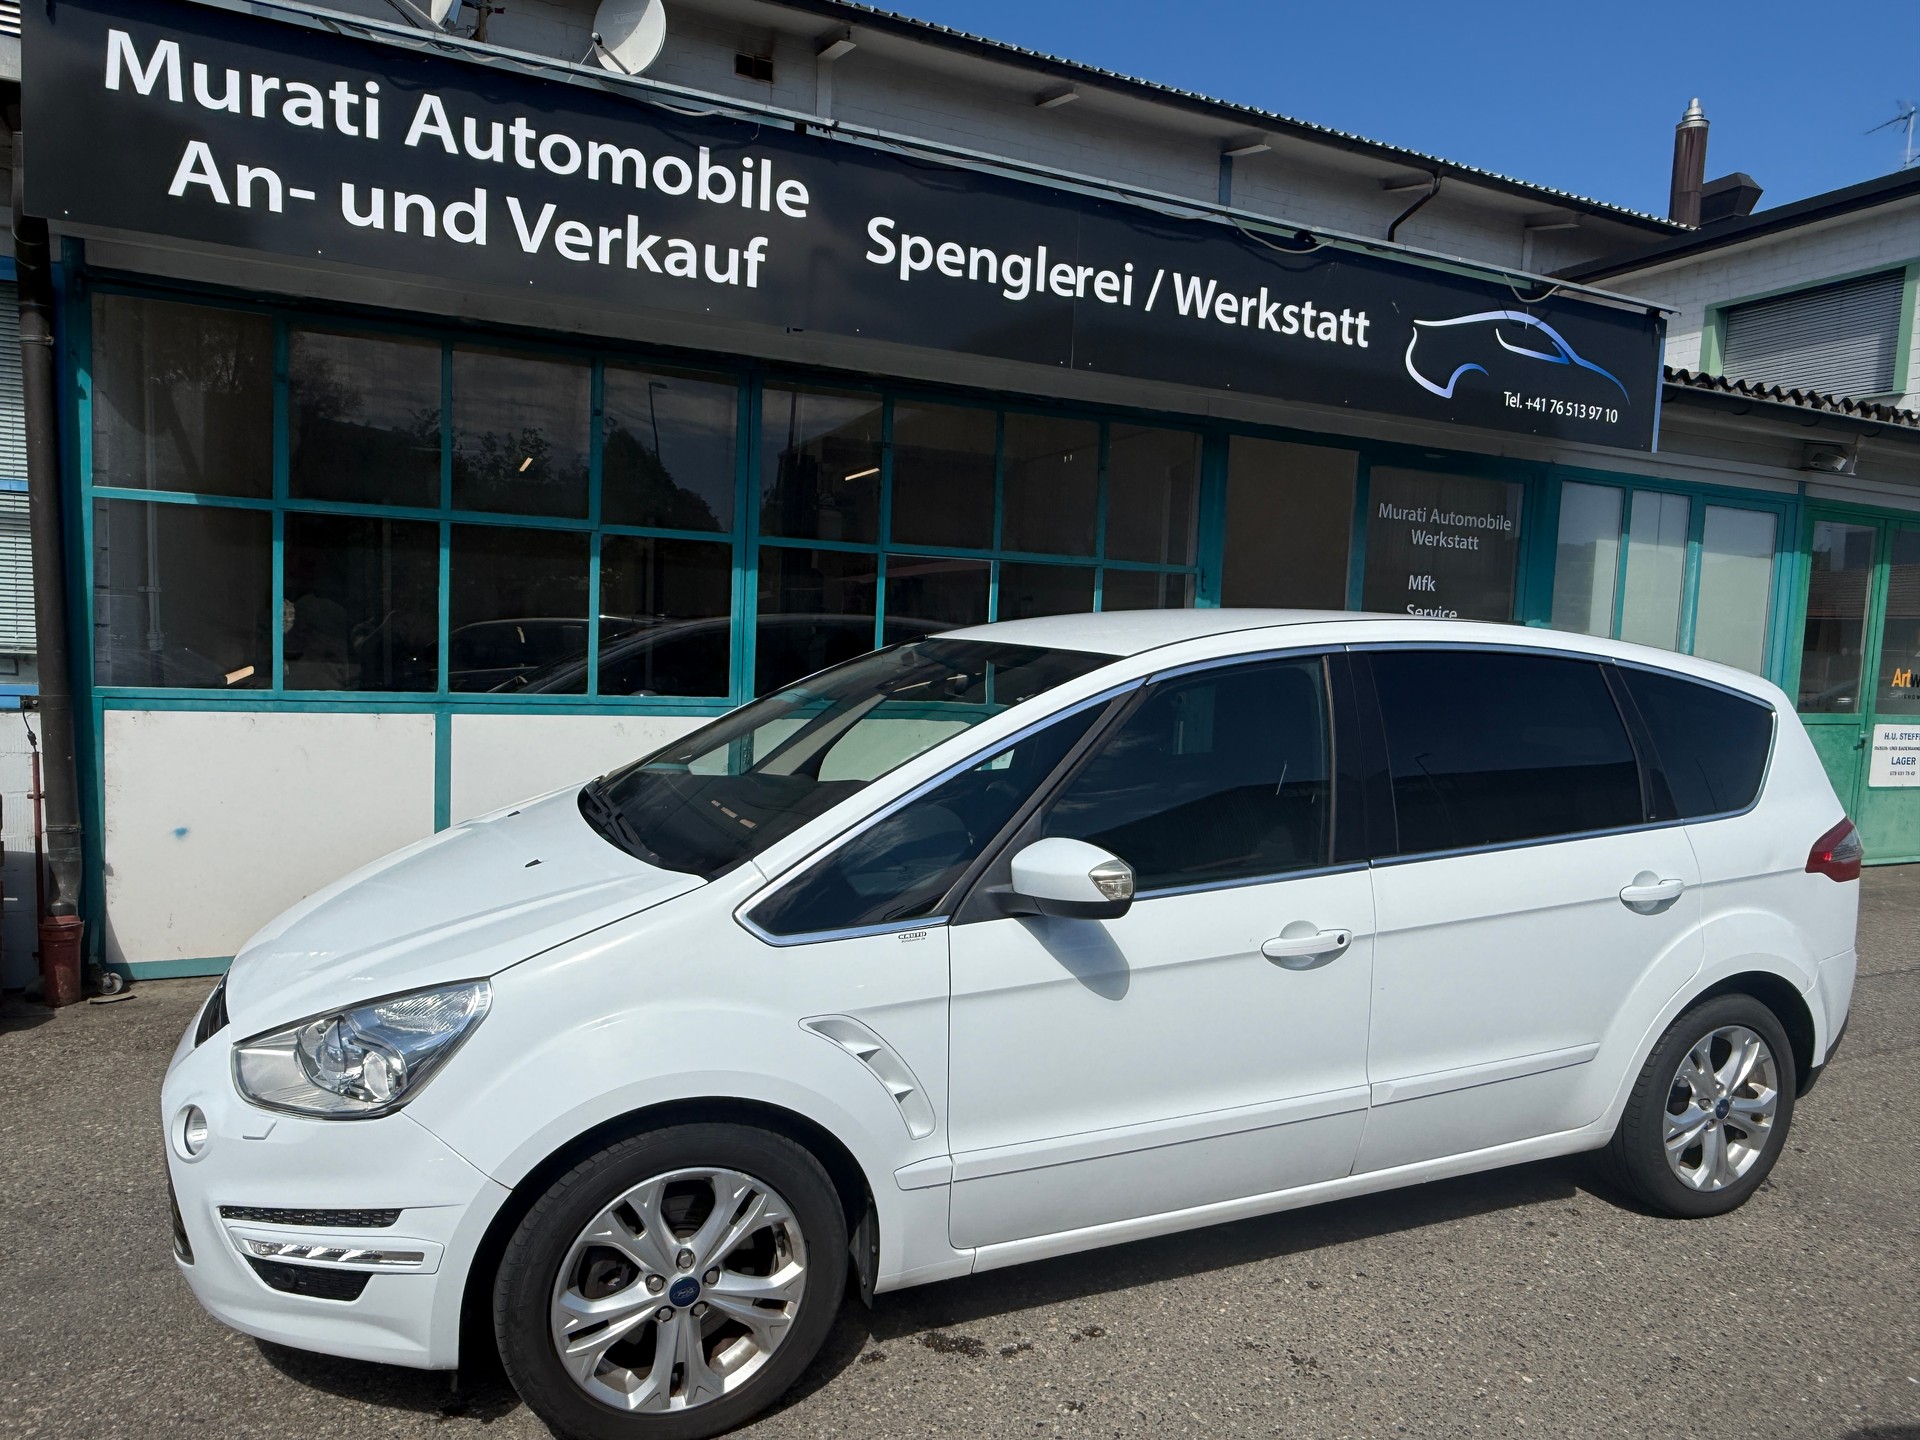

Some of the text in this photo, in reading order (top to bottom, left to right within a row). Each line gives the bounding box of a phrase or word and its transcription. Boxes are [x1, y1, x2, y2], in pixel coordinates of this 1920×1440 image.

[104, 28, 811, 219] Murati Automobile
[168, 140, 769, 289] An- und Verkauf
[865, 216, 1135, 307] Spenglerei
[1173, 273, 1370, 348] Werkstatt
[1503, 391, 1619, 423] Tel. +41 76 513 97 10
[1378, 502, 1512, 531] Murati Automobile
[1411, 529, 1479, 550] Werkstatt
[1408, 574, 1436, 592] Mfk
[1406, 603, 1458, 619] Service
[1899, 732, 1920, 741] STEFF
[1891, 756, 1917, 766] LAGER
